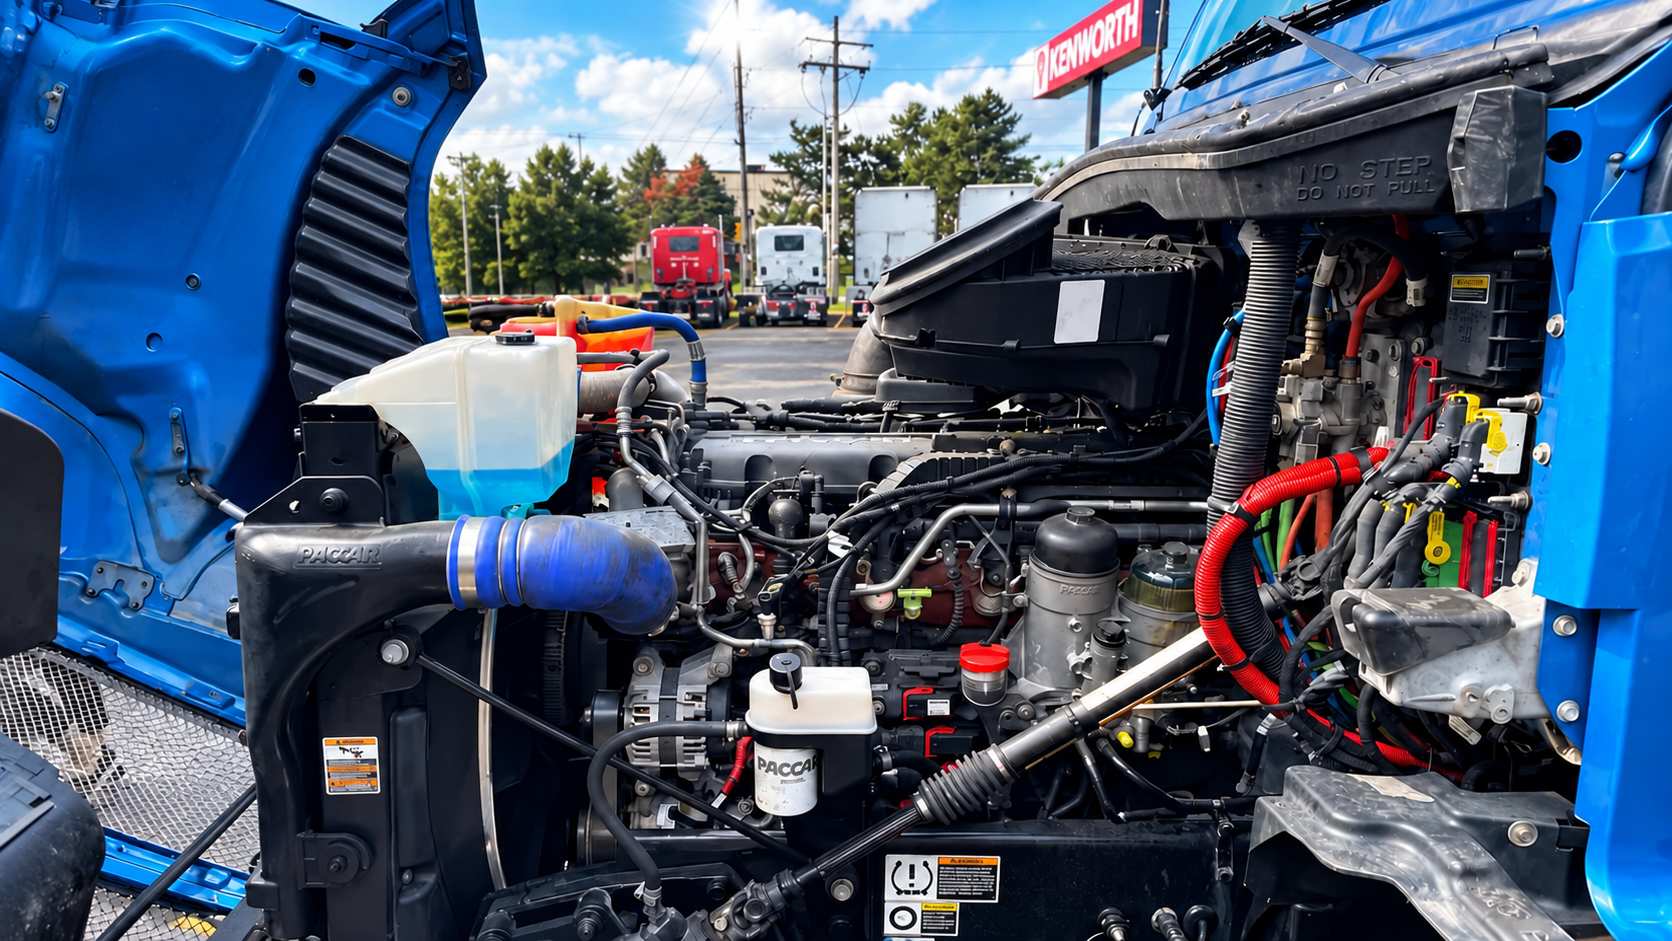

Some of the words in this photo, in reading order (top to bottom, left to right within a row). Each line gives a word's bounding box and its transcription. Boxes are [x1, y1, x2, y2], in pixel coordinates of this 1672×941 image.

[1049, 0, 1139, 81] KENWORTH
[1300, 163, 1337, 184] NO
[1297, 186, 1323, 201] DO
[1336, 183, 1375, 199] NOT
[1388, 179, 1435, 196] PULL
[297, 546, 382, 565] PACCAR
